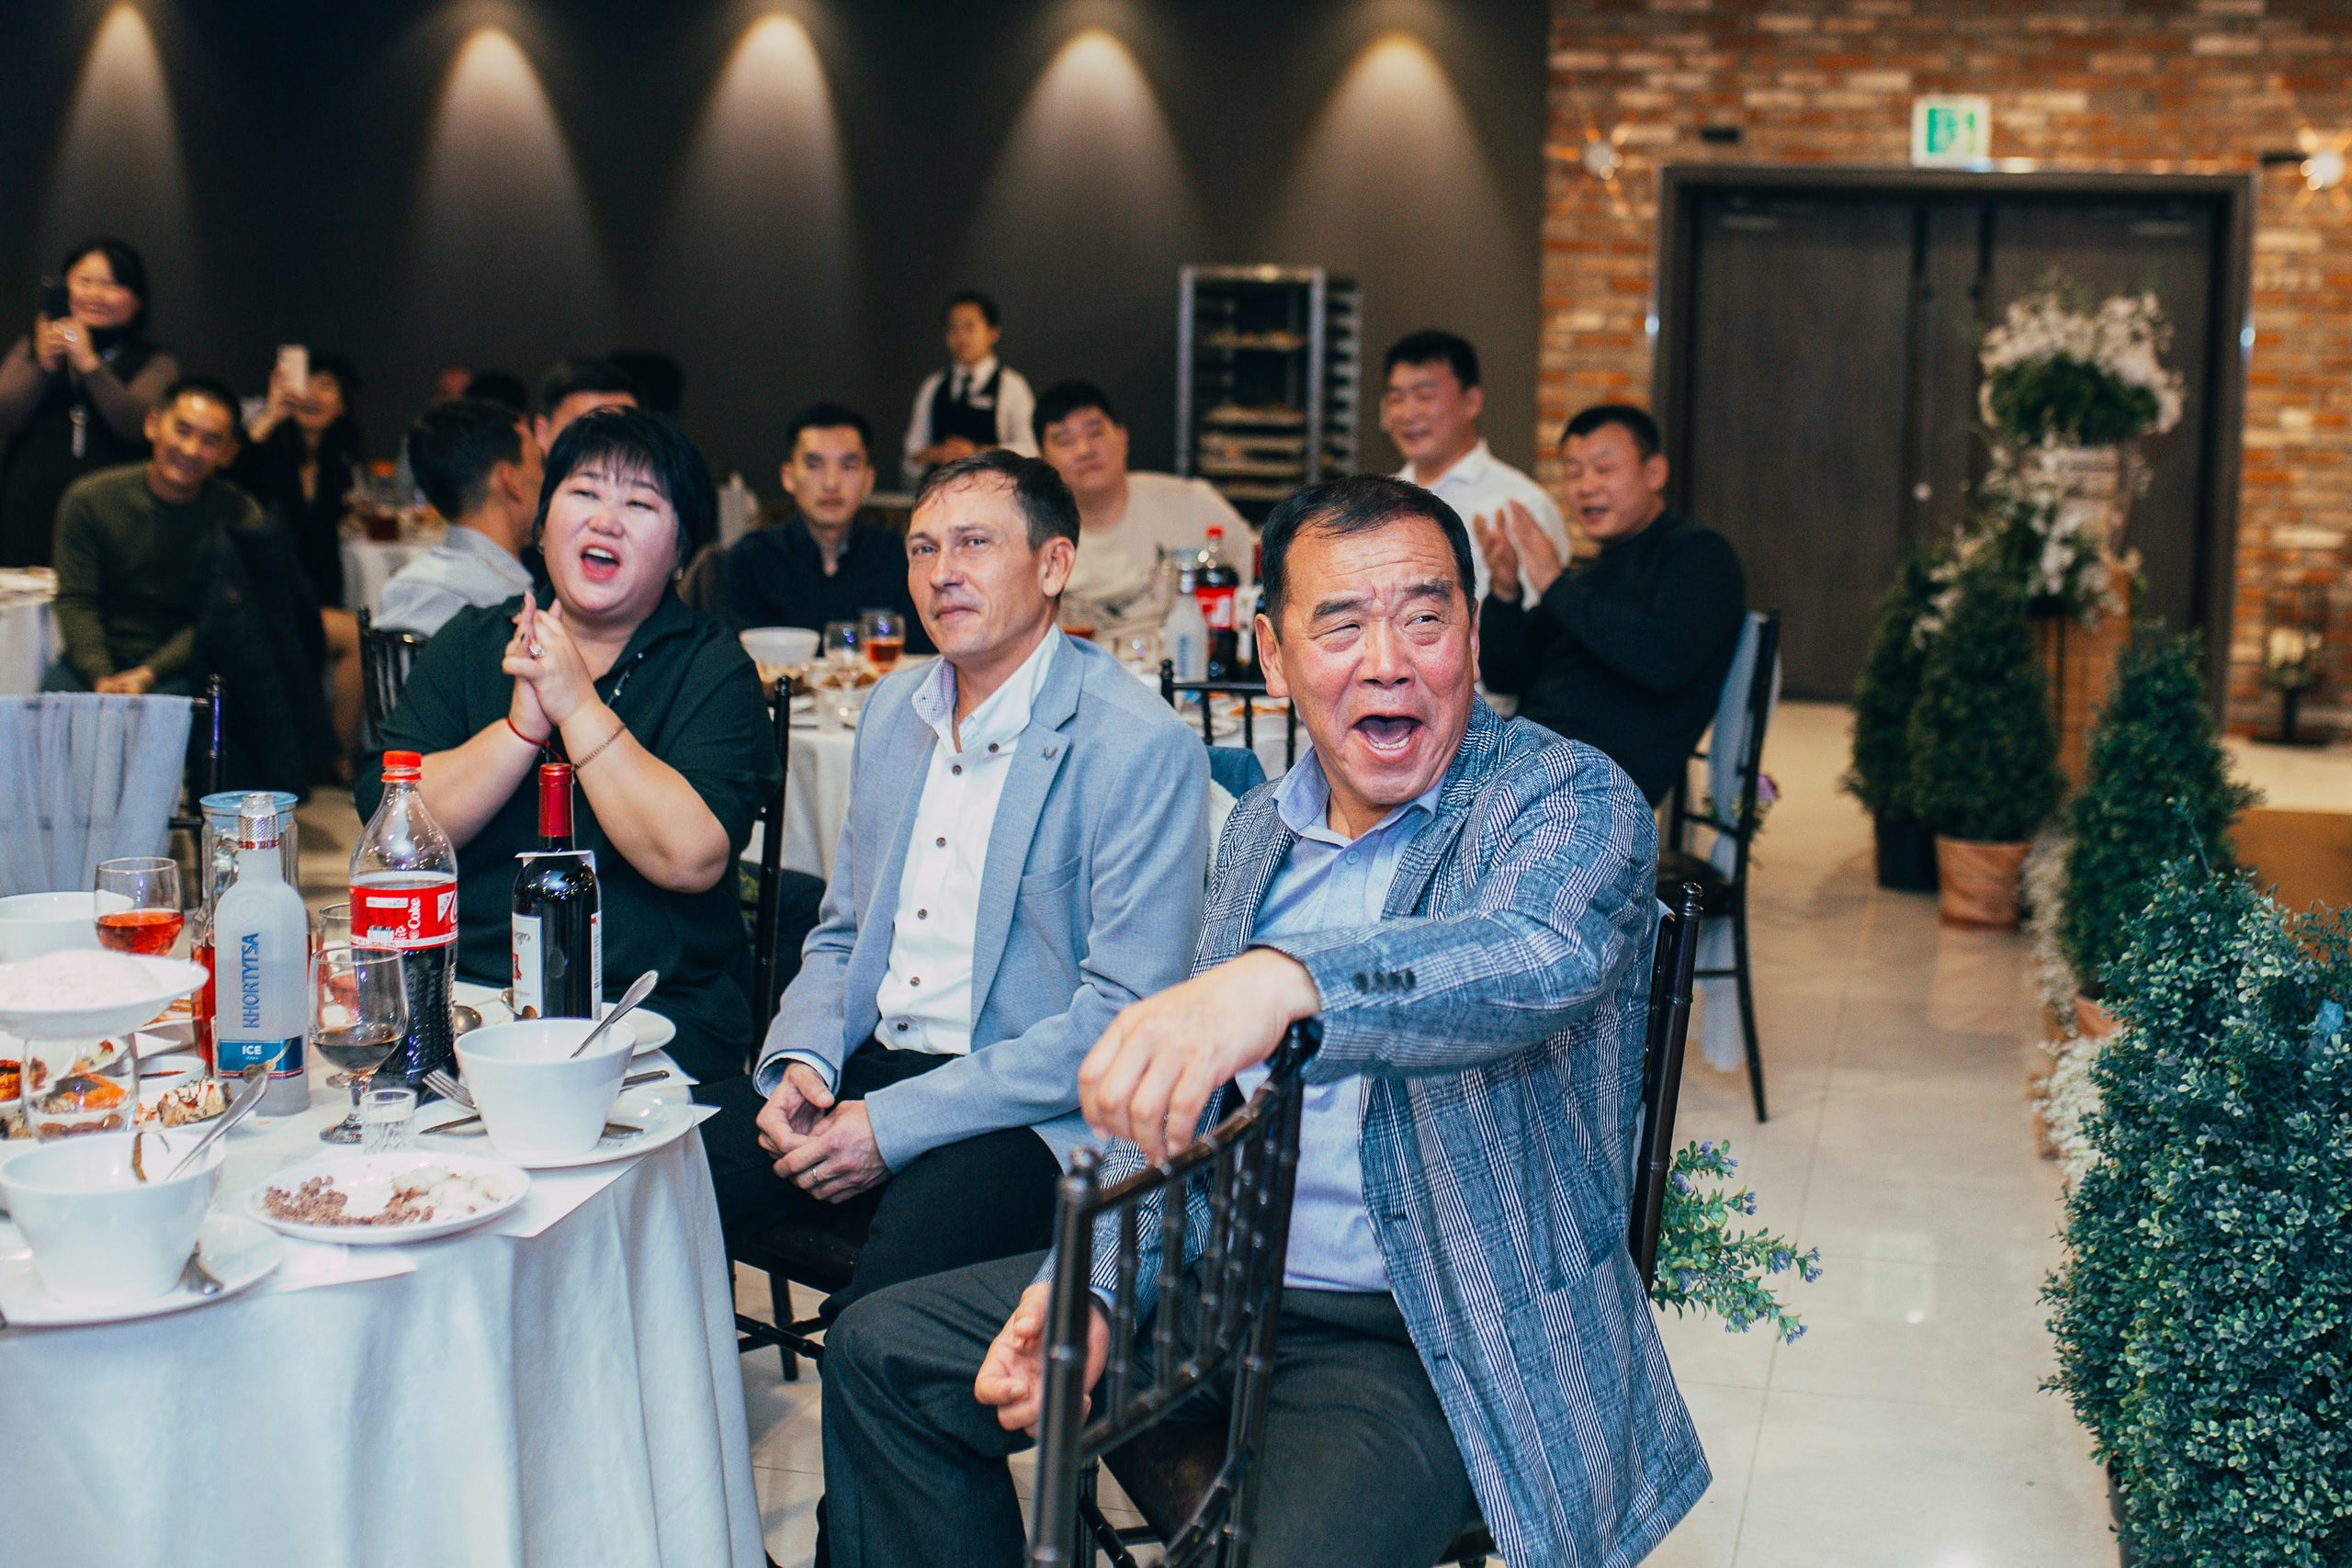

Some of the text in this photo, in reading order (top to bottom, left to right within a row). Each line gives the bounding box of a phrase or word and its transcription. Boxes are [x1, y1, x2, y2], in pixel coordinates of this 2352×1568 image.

[408, 897, 421, 930] Coke
[242, 932, 260, 1029] KHORTYTSA
[242, 1045, 263, 1055] ICE
